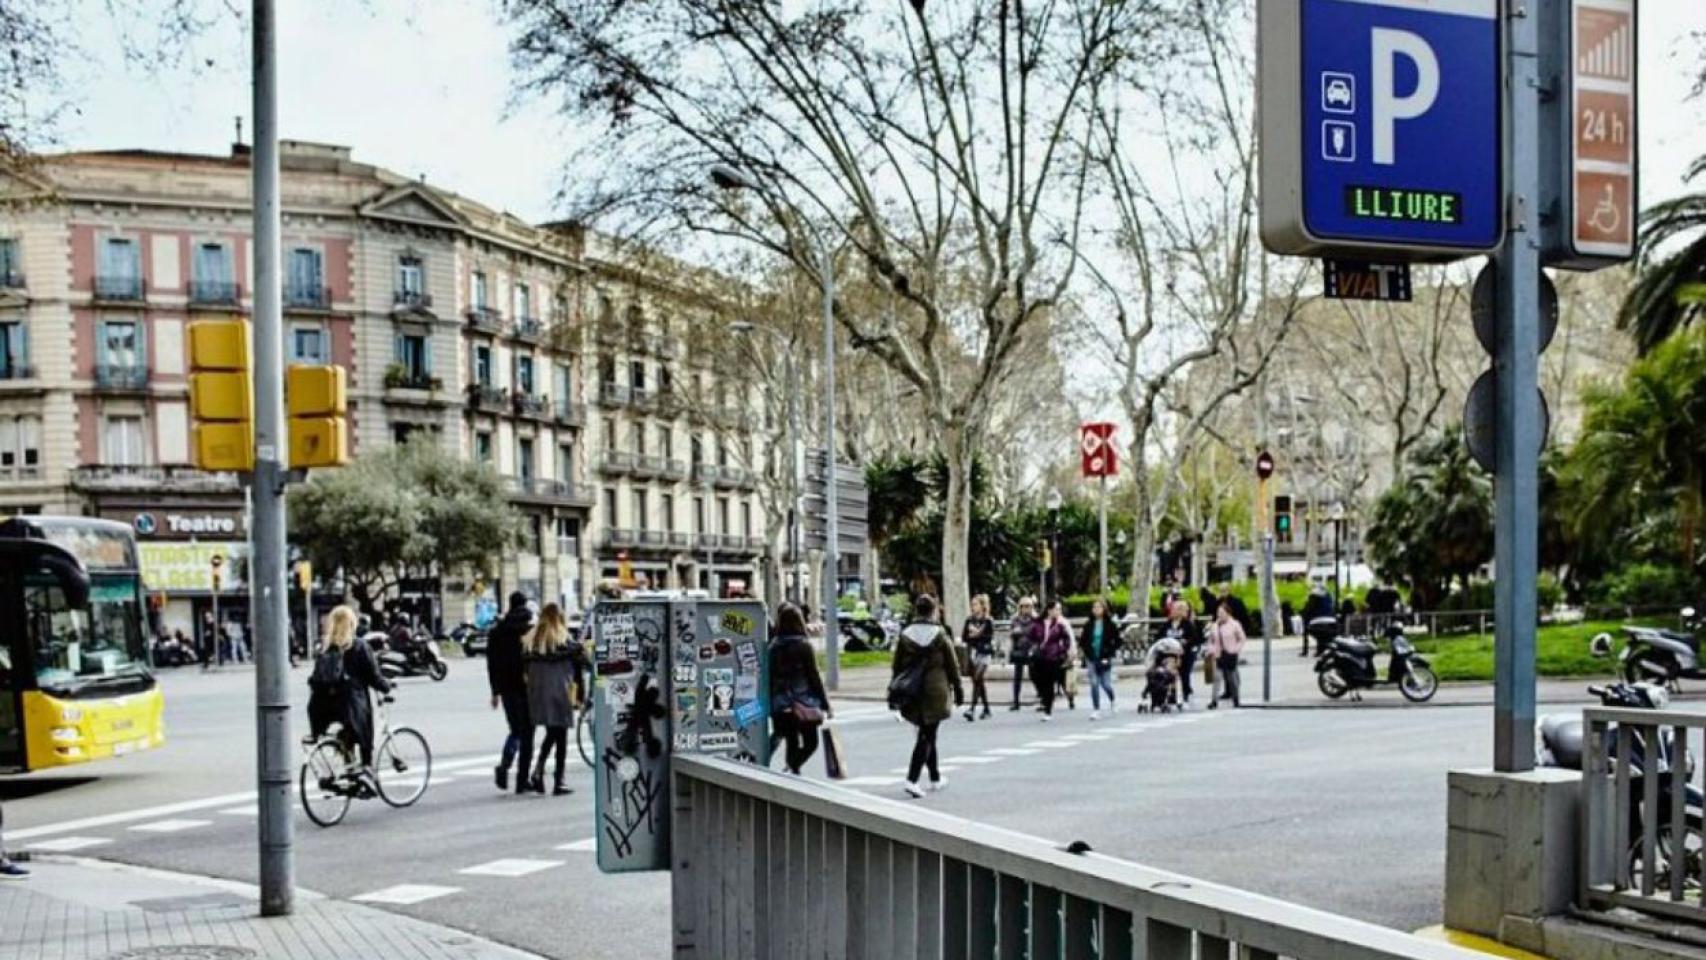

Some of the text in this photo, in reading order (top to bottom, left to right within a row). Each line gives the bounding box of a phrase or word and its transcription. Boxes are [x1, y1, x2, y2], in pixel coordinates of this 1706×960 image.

[1371, 26, 1440, 165] P
[1582, 109, 1625, 145] 24 h
[167, 514, 236, 533] Teatre
